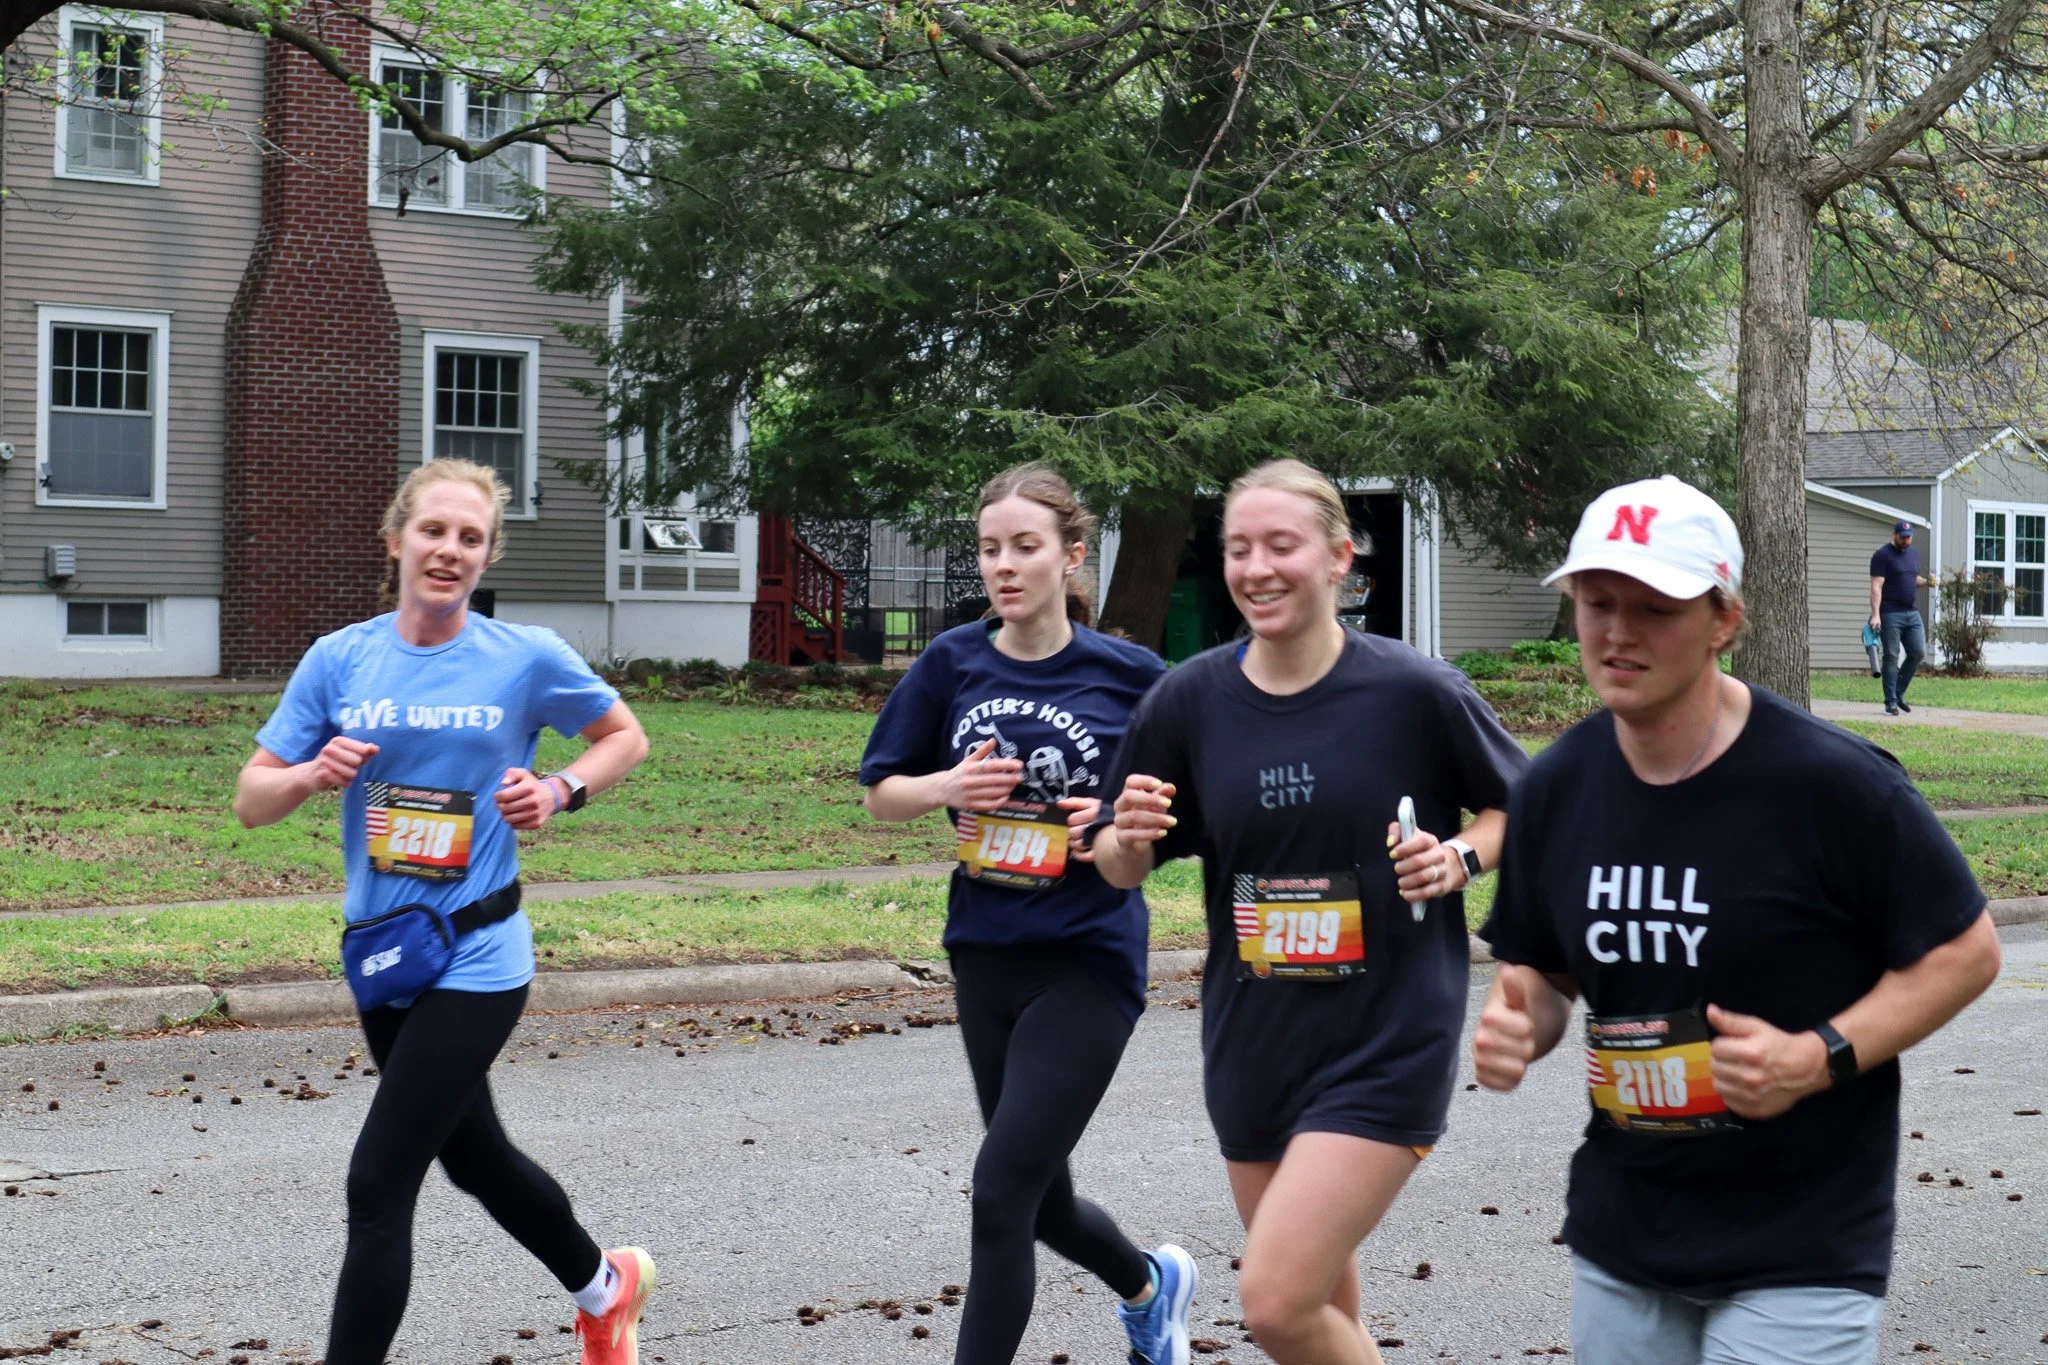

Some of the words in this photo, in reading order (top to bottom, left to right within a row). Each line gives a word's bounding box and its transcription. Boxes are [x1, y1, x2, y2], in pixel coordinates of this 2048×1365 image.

[1607, 505, 1659, 545] N
[406, 705, 504, 731] UNITED
[1259, 762, 1315, 788] HILL
[1260, 784, 1314, 809] CITY
[387, 816, 457, 859] 2218
[977, 824, 1050, 868] 1984
[1587, 865, 1710, 914] HILL
[1262, 910, 1341, 955] 2199
[1586, 920, 1708, 967] CITY
[1611, 1056, 1687, 1107] 2118
